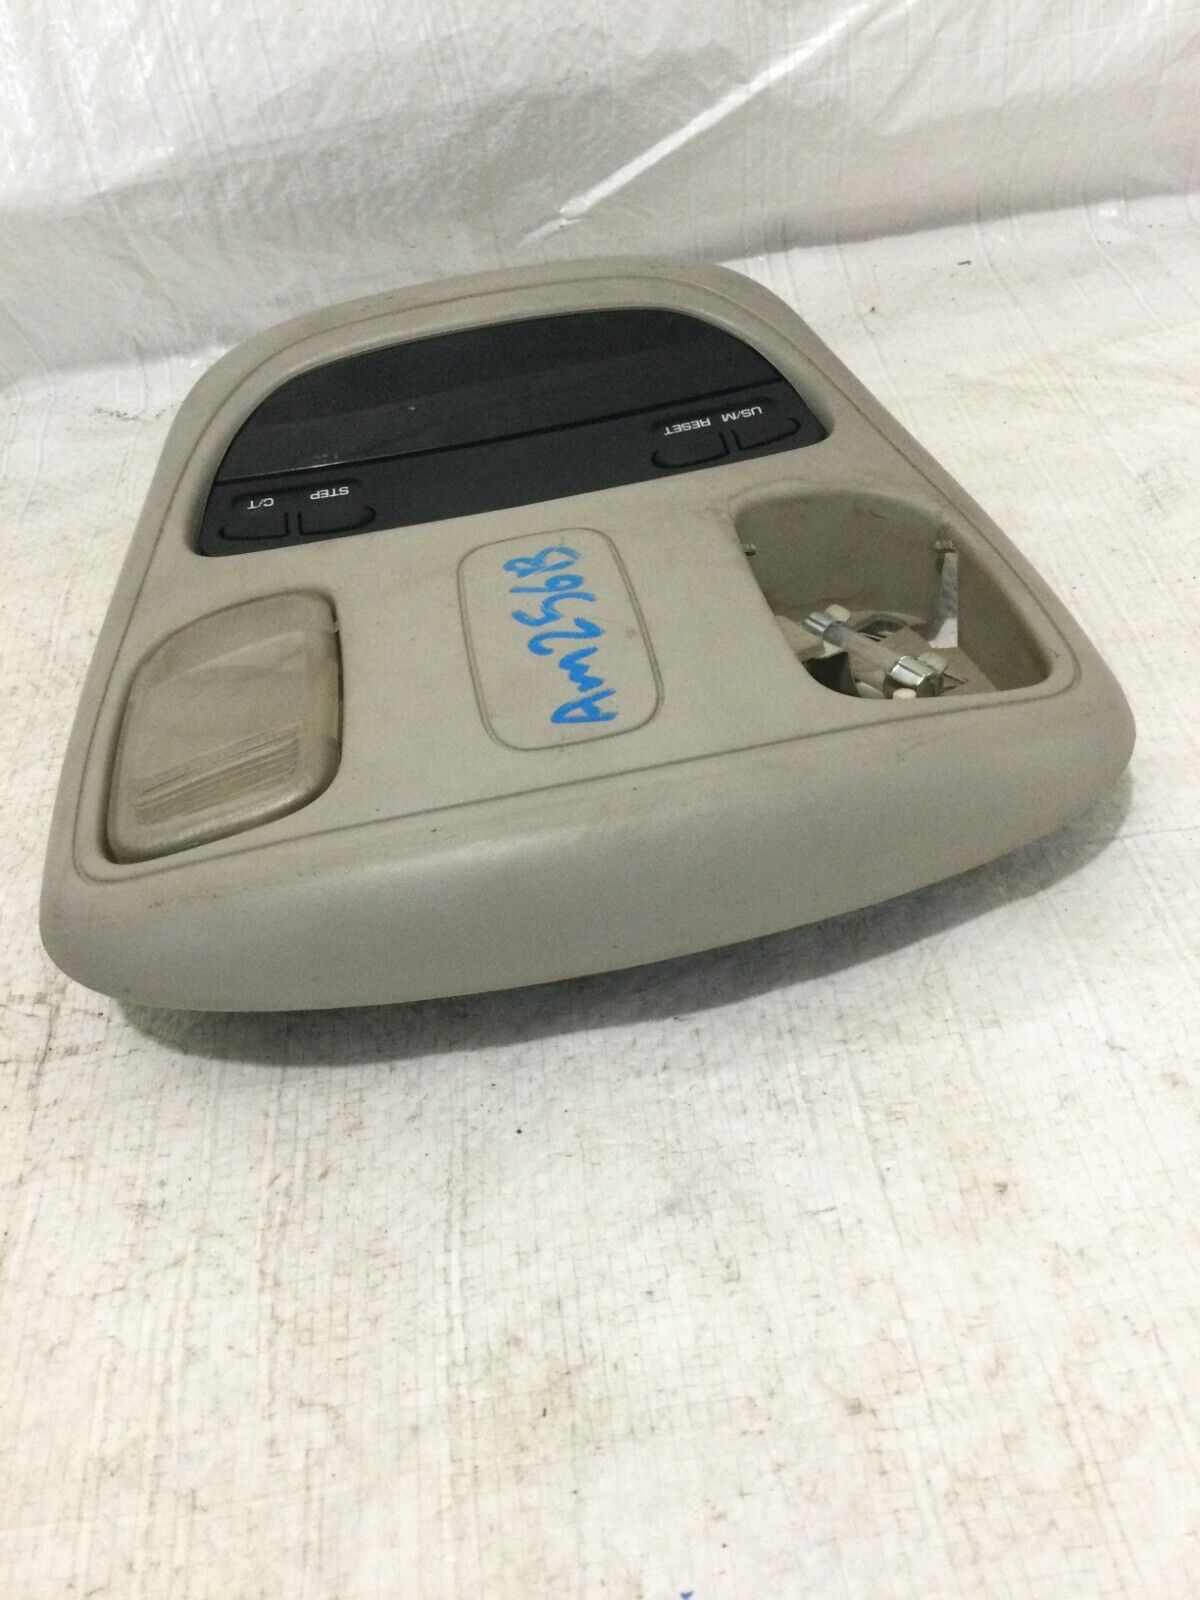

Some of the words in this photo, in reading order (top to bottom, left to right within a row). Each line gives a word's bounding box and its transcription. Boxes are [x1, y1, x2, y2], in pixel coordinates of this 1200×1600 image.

[721, 406, 763, 423] US/M
[664, 417, 712, 436] RESET
[309, 486, 350, 500] STEP
[247, 497, 275, 510] C/T
